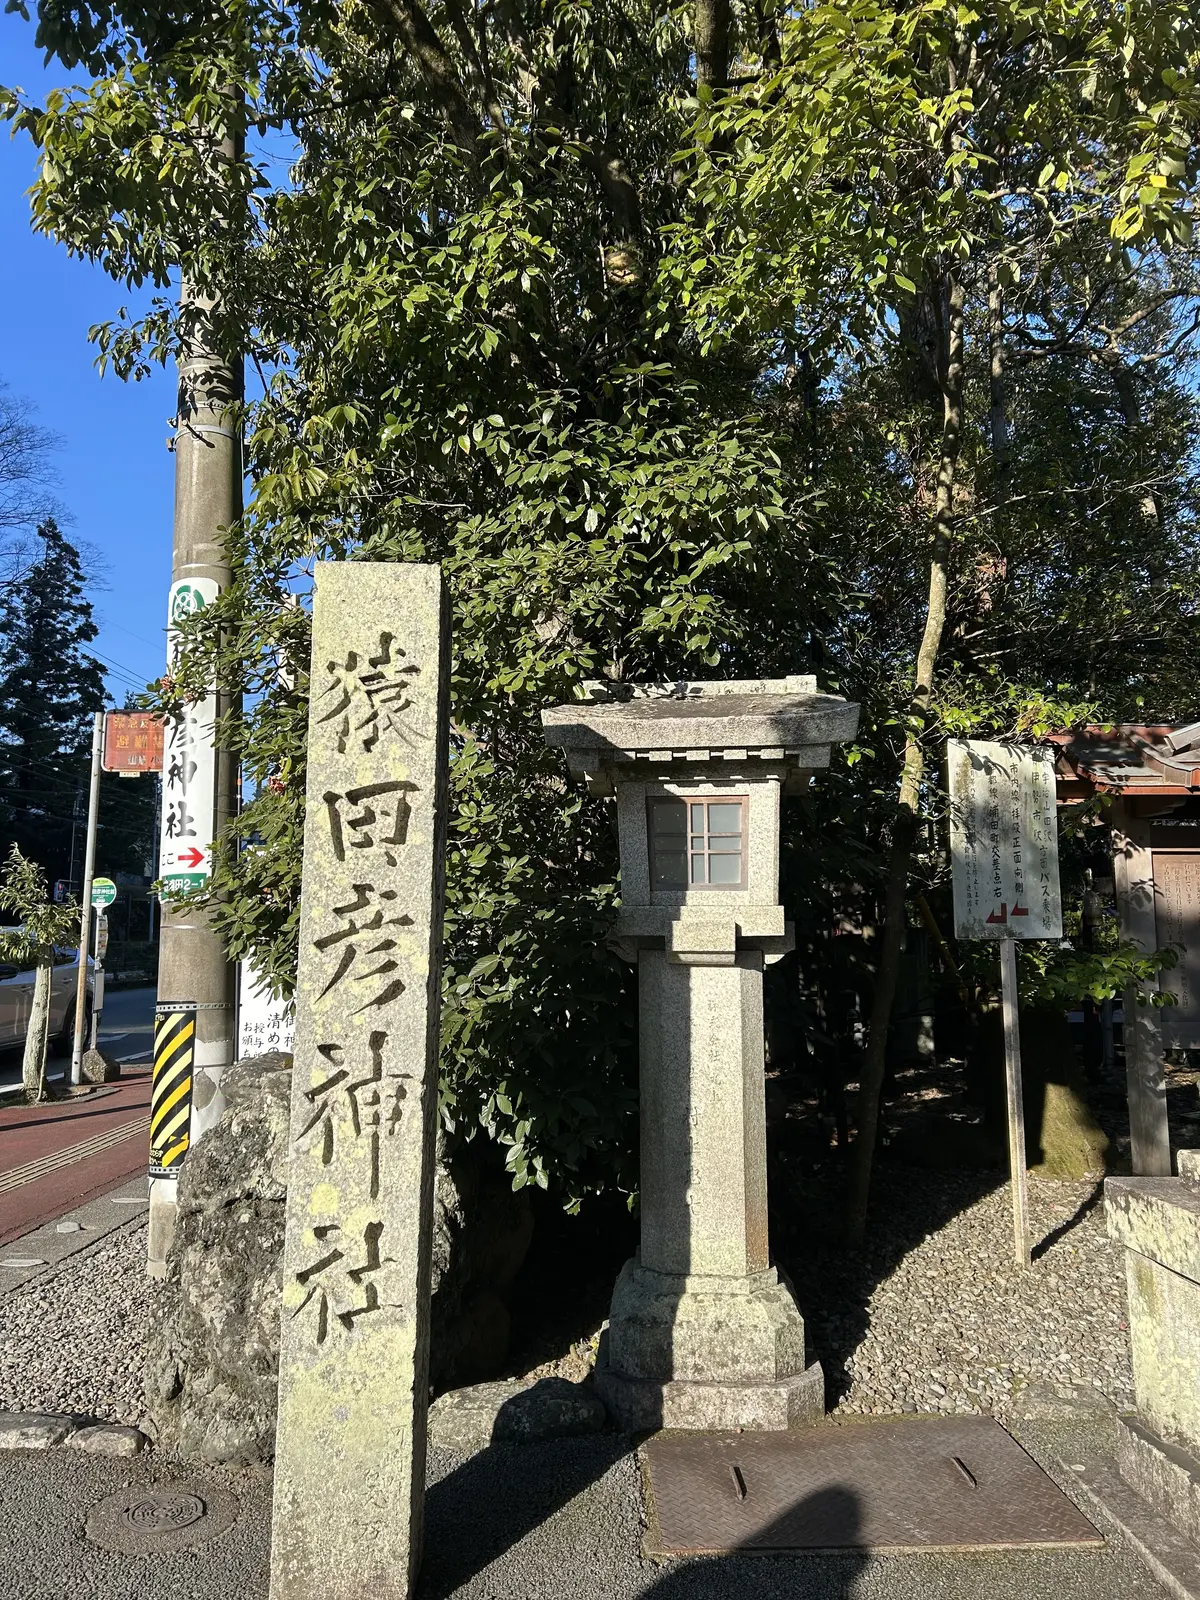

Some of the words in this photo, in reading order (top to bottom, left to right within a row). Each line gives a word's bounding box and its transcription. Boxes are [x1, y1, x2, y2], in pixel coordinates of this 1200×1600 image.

[290, 631, 428, 1345] 猿田彦神社
